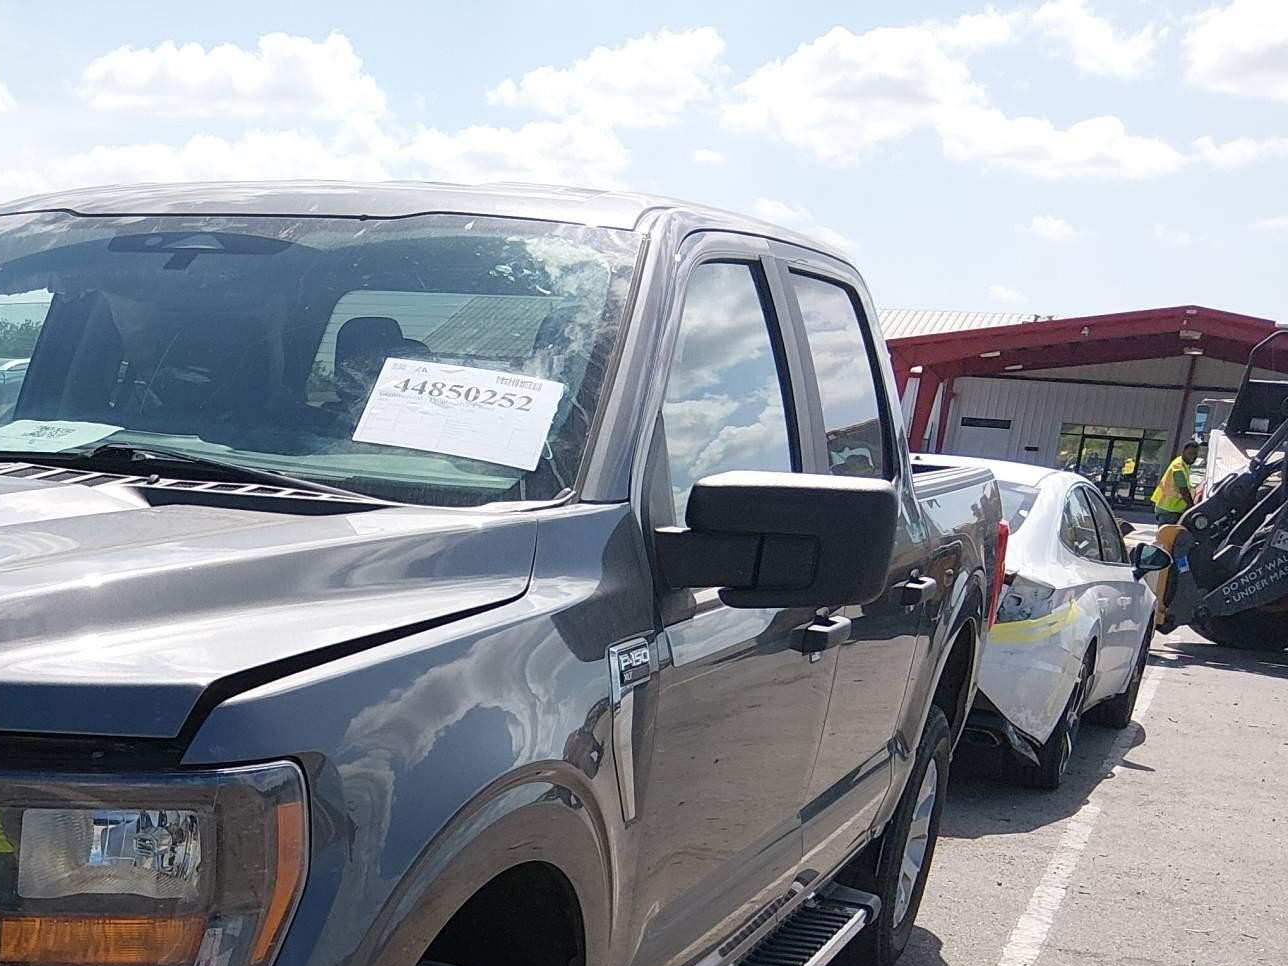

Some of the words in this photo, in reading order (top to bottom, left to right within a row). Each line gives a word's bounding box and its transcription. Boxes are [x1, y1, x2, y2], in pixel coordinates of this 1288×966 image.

[393, 378, 533, 412] 44850252
[1222, 581, 1239, 595] DO
[1240, 567, 1263, 585] NOT
[1232, 578, 1268, 602] UNDER
[619, 648, 649, 670] F-150
